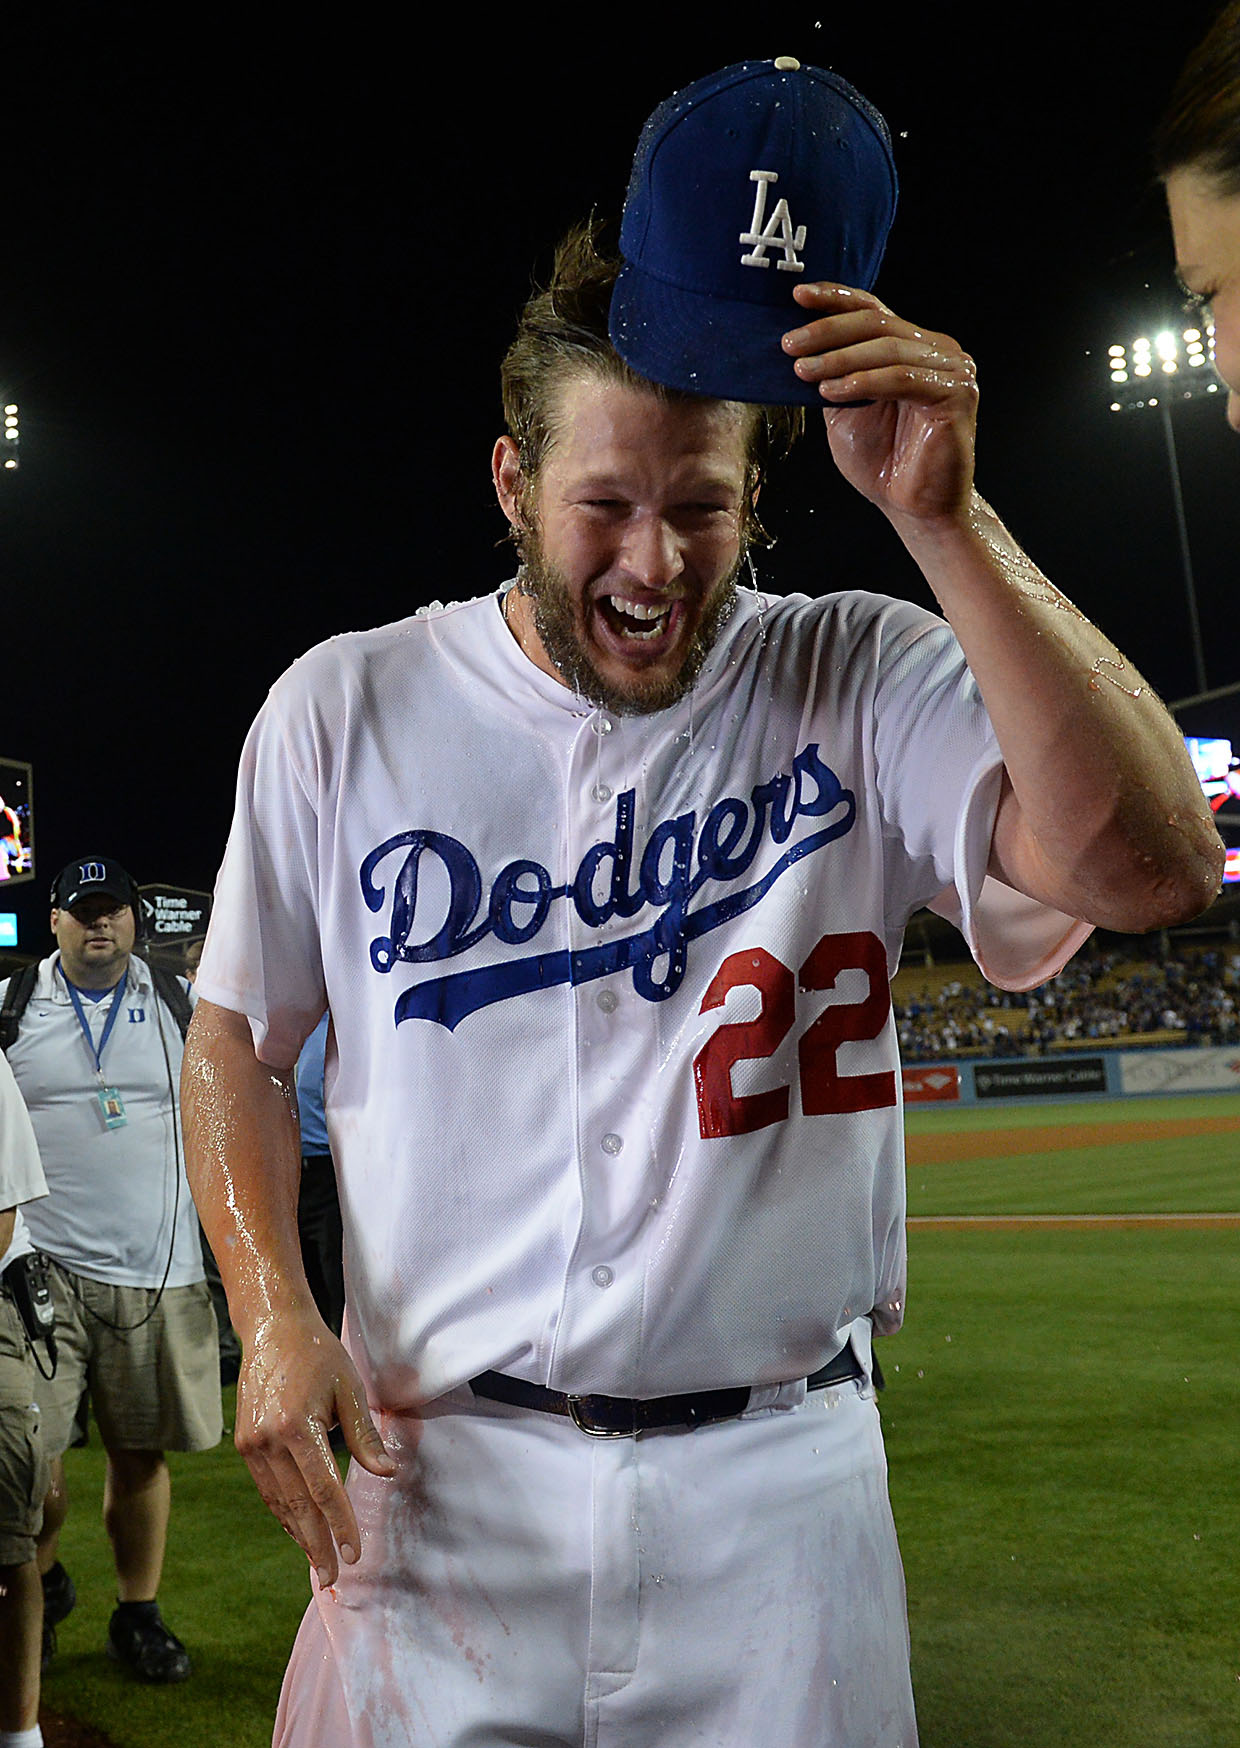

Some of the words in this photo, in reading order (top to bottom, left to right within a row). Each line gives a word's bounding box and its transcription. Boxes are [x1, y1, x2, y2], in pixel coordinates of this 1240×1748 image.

[739, 169, 807, 272] LA
[360, 743, 856, 1003] Dodgers
[154, 896, 187, 909] Time
[154, 908, 202, 921] Warner
[154, 920, 193, 933] Cable
[693, 930, 897, 1140] 22
